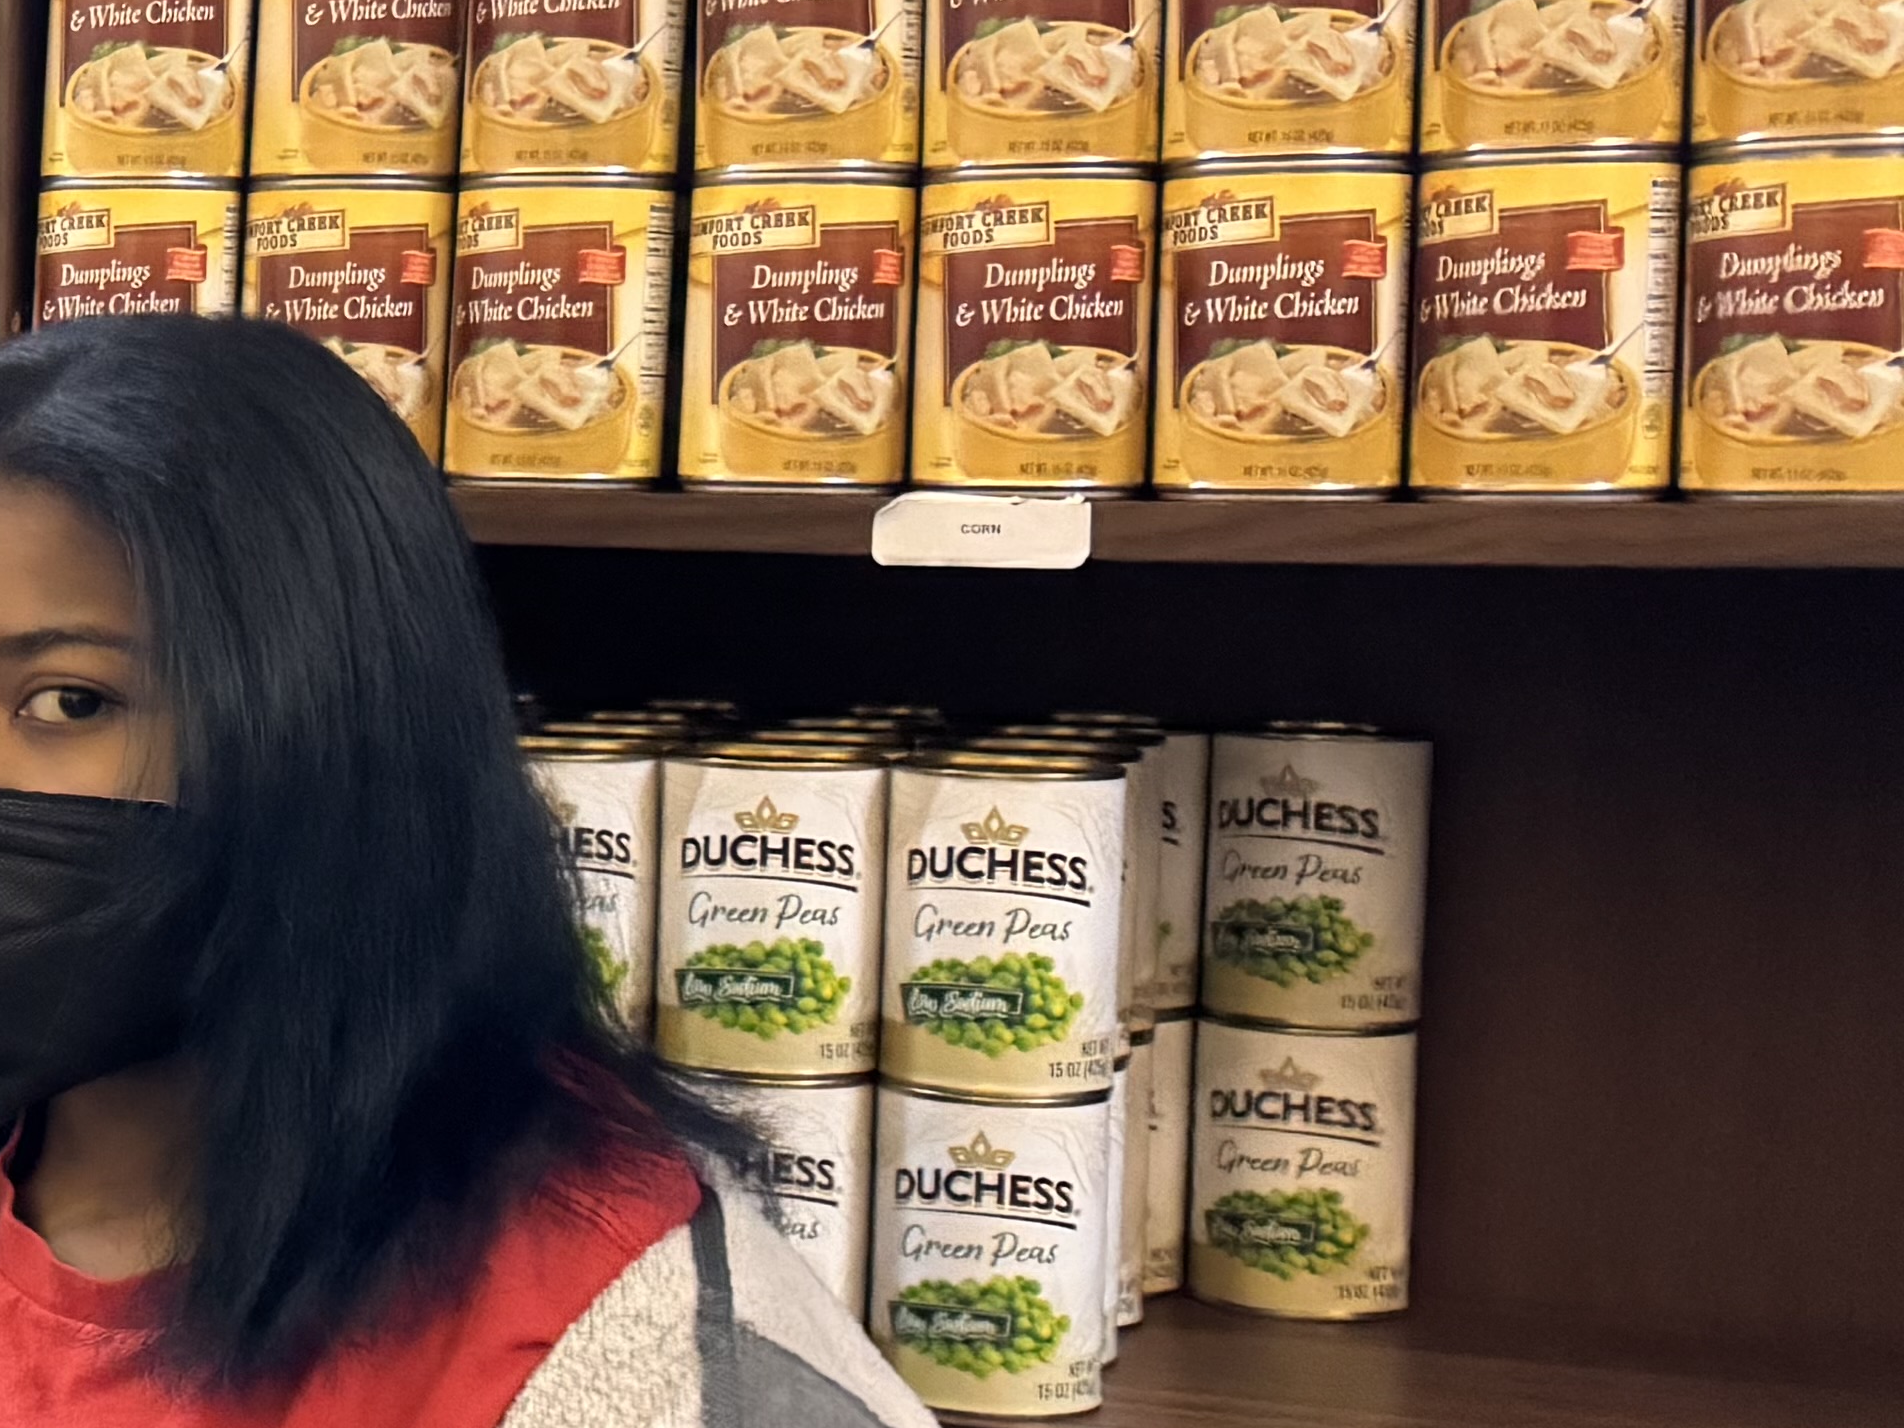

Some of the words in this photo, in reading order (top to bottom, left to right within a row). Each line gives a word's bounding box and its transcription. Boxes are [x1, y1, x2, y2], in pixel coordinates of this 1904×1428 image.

[71, 9, 85, 31] &
[90, 4, 142, 29] White
[145, 0, 216, 24] Chicken
[750, 210, 809, 230] CREEK
[713, 231, 762, 248] FOODS
[289, 262, 386, 292] Dumplings
[471, 262, 561, 294] Dumplings
[752, 262, 859, 293] Dumplings
[985, 259, 1095, 292] Dumplings
[1209, 255, 1324, 290] Dumplings
[724, 303, 744, 325] &
[749, 298, 806, 322] White
[809, 294, 885, 319] Chicken
[960, 522, 1001, 535] CORN
[1218, 798, 1379, 838] DUCHESS
[681, 835, 856, 875] DUCHESS
[907, 847, 1089, 890] DUCHESS
[1224, 850, 1288, 880] Green
[1296, 854, 1362, 885] Peas
[689, 891, 769, 927] Green
[774, 893, 842, 930] Peas
[914, 903, 995, 941] Green
[1003, 907, 1071, 945] Peas
[1211, 1089, 1377, 1130] DUCHESS
[1217, 1140, 1288, 1172] Green
[1298, 1147, 1361, 1178] Peas
[895, 1169, 1073, 1213] DUCHESS
[902, 1225, 983, 1260] Green
[991, 1232, 1059, 1266] Peas
